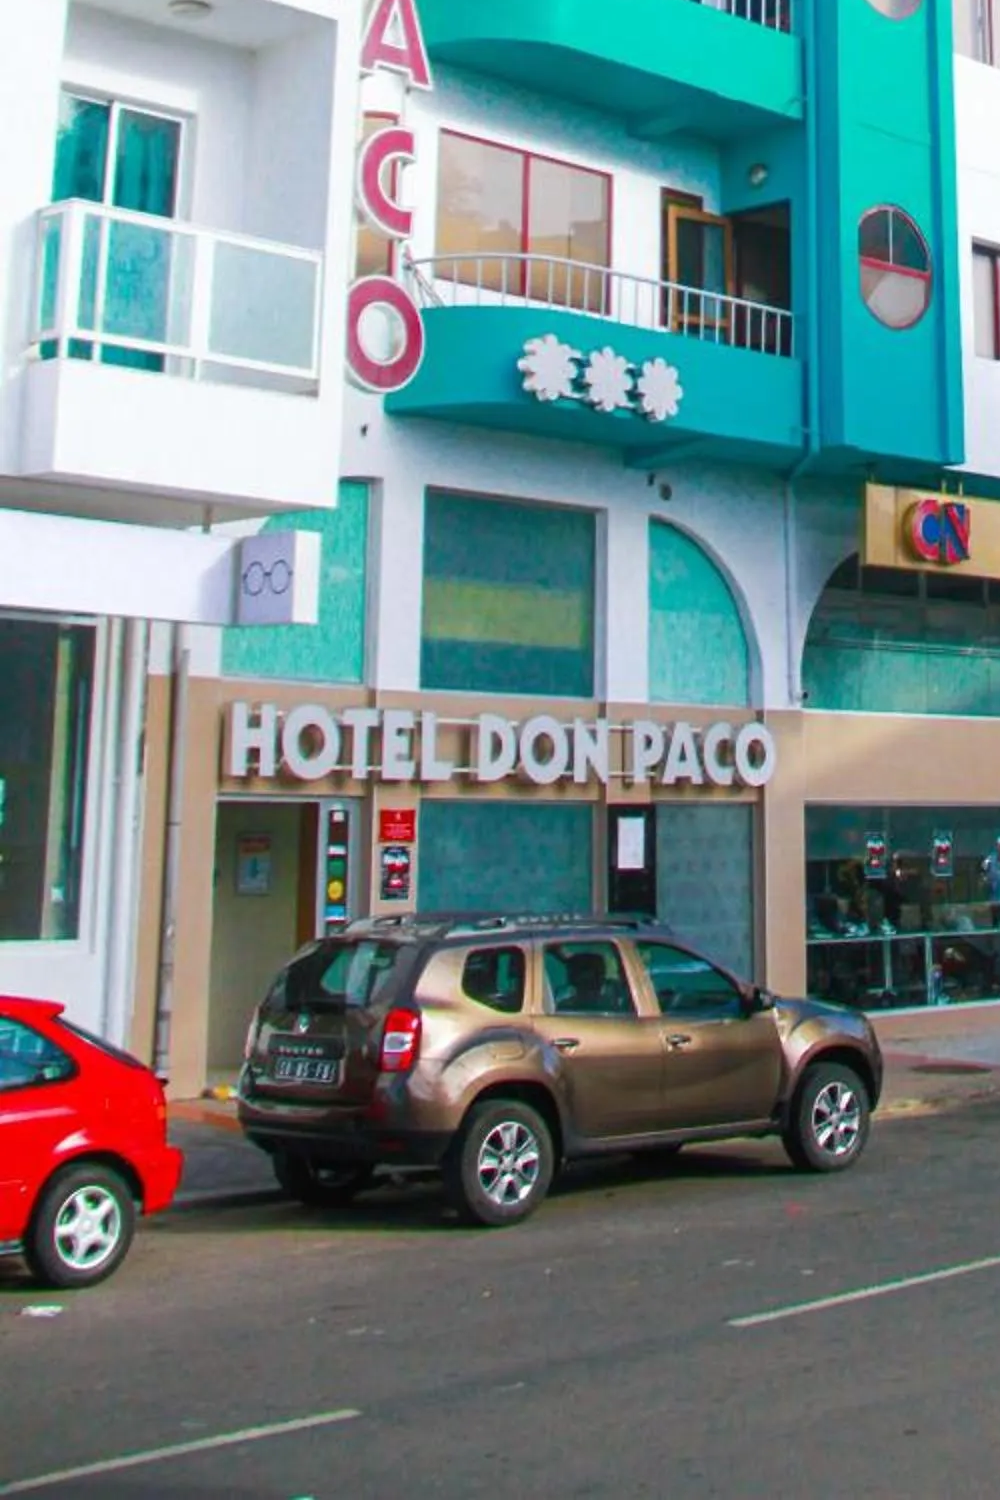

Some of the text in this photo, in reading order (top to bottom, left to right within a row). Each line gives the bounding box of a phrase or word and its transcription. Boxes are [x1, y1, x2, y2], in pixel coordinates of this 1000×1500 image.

[229, 701, 776, 787] HOTEL DON PACO
